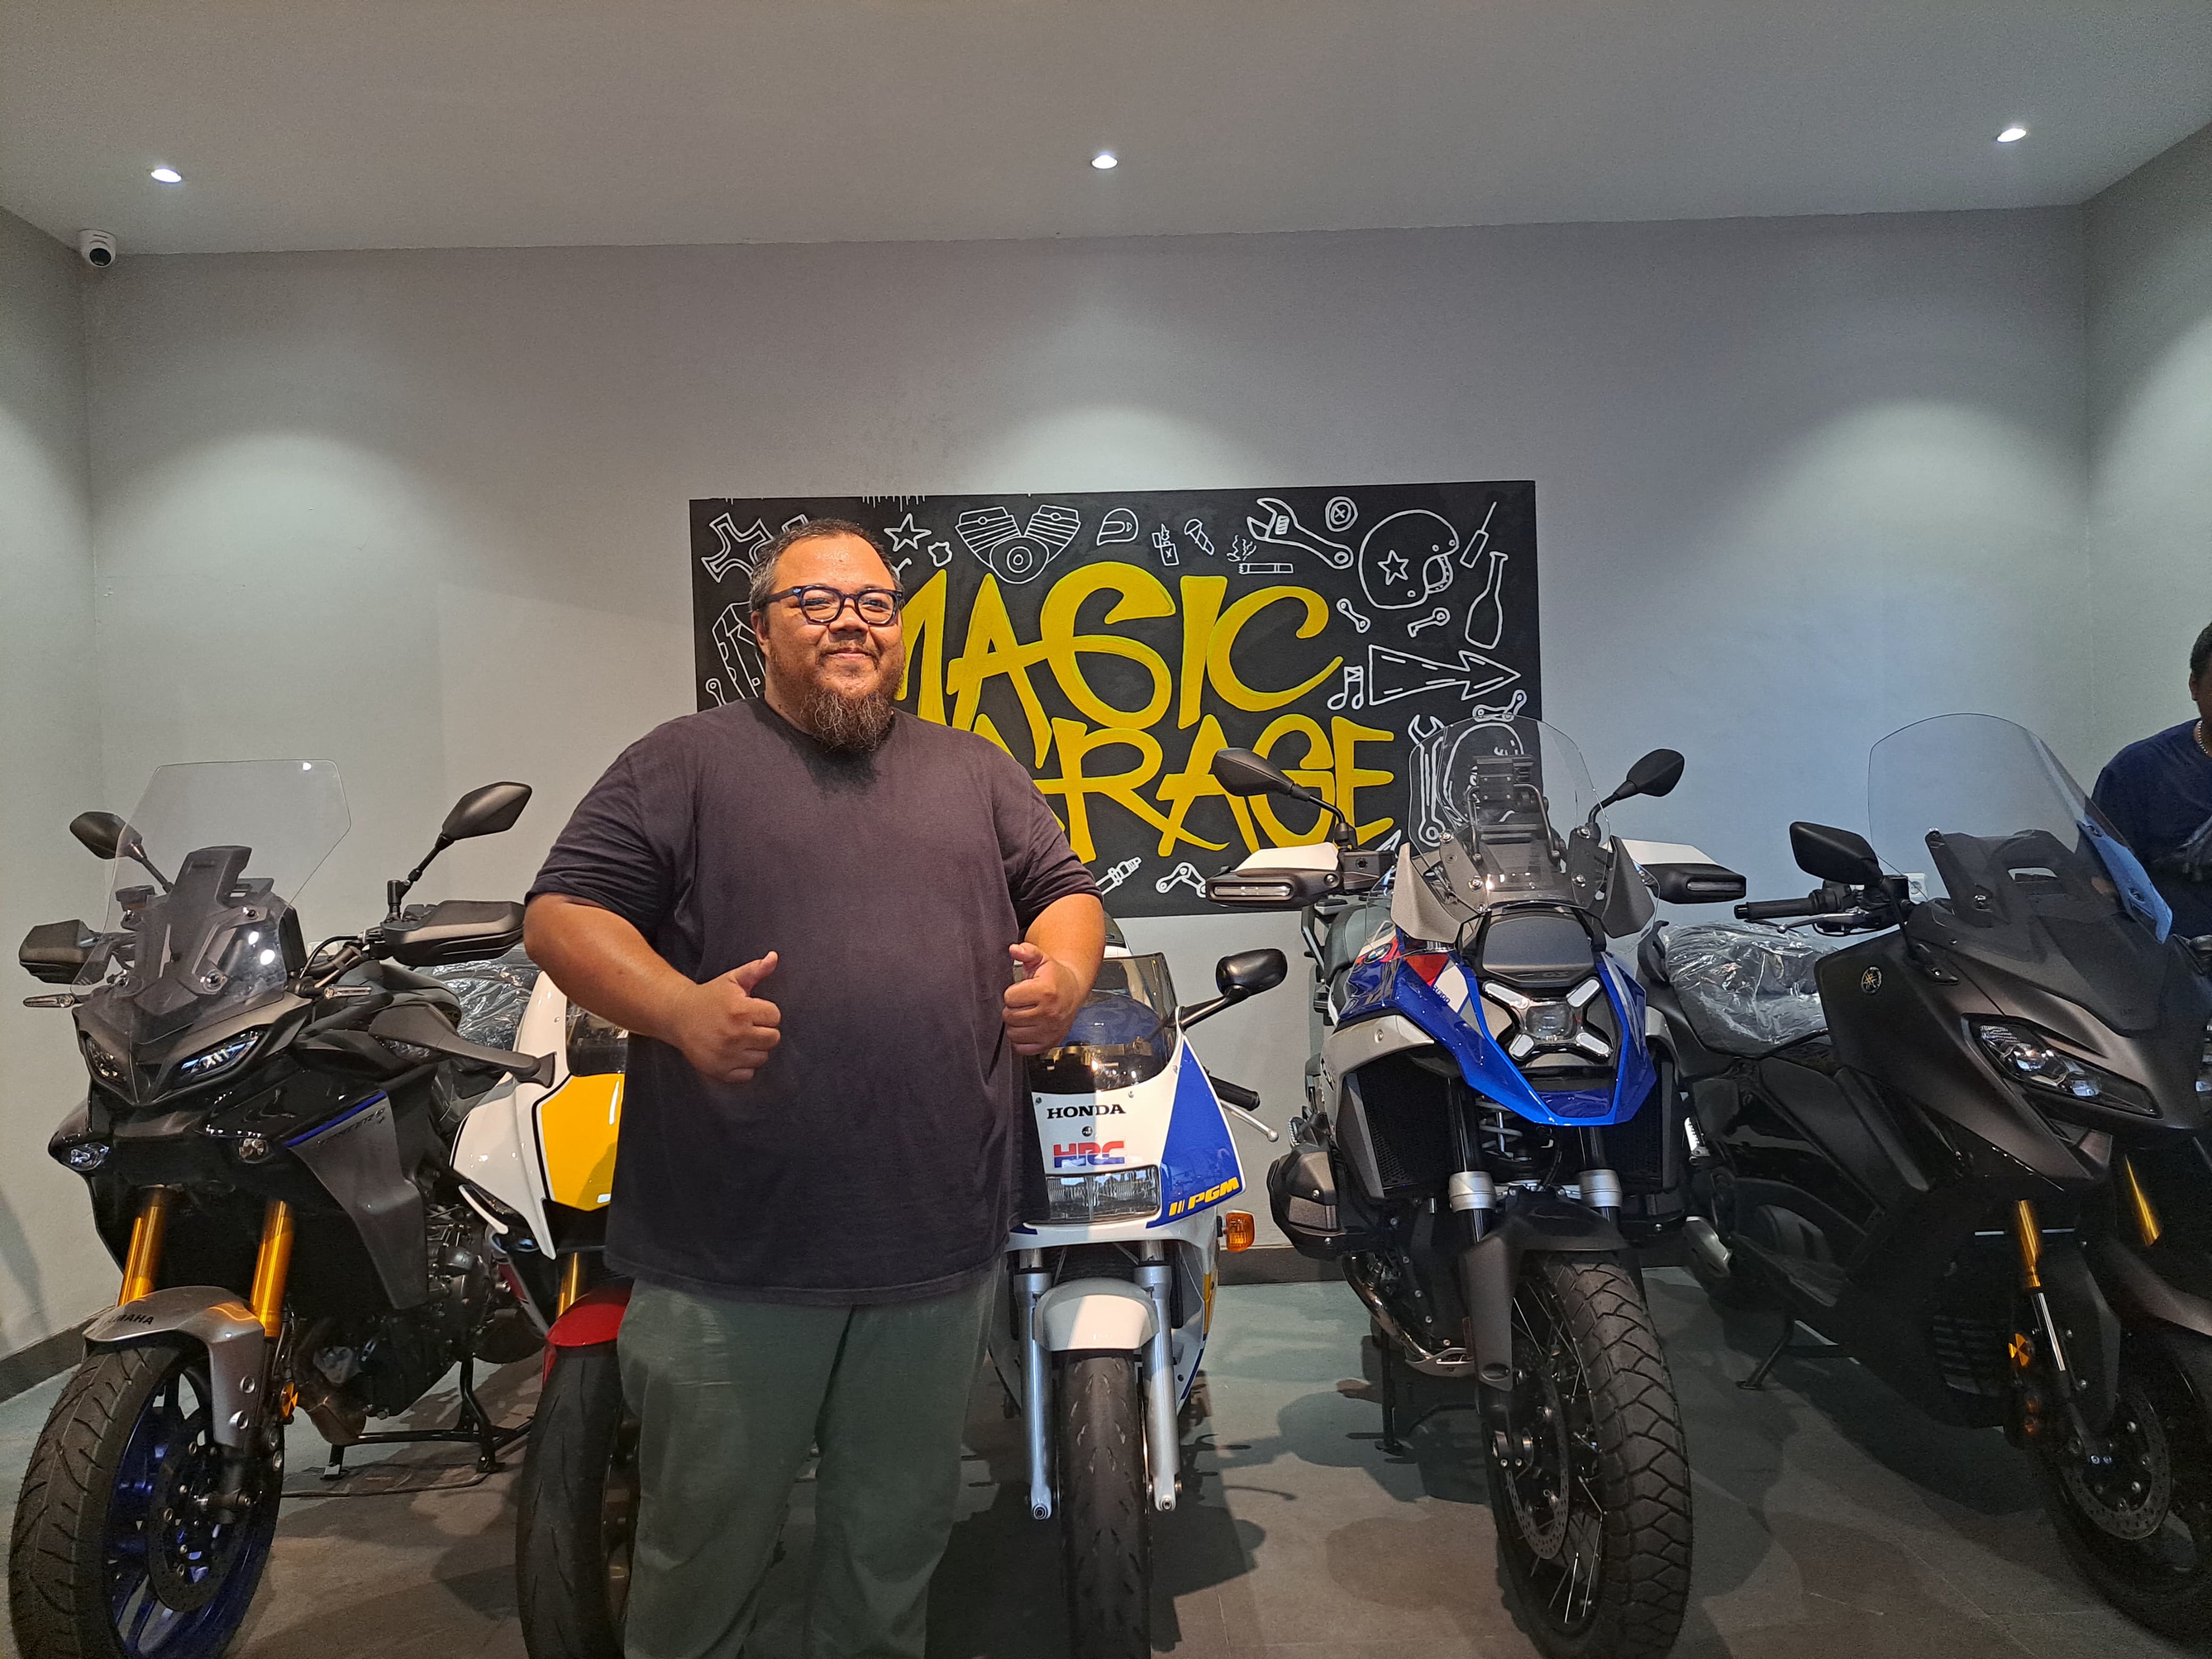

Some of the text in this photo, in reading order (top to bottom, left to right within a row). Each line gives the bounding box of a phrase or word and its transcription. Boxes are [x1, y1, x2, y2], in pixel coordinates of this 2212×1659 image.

[974, 714, 1394, 862] RAGE
[1046, 1104, 1126, 1119] HONDA
[1053, 1140, 1125, 1168] HRC
[1187, 1176, 1239, 1210] PGM
[103, 1314, 154, 1325] MAHA
